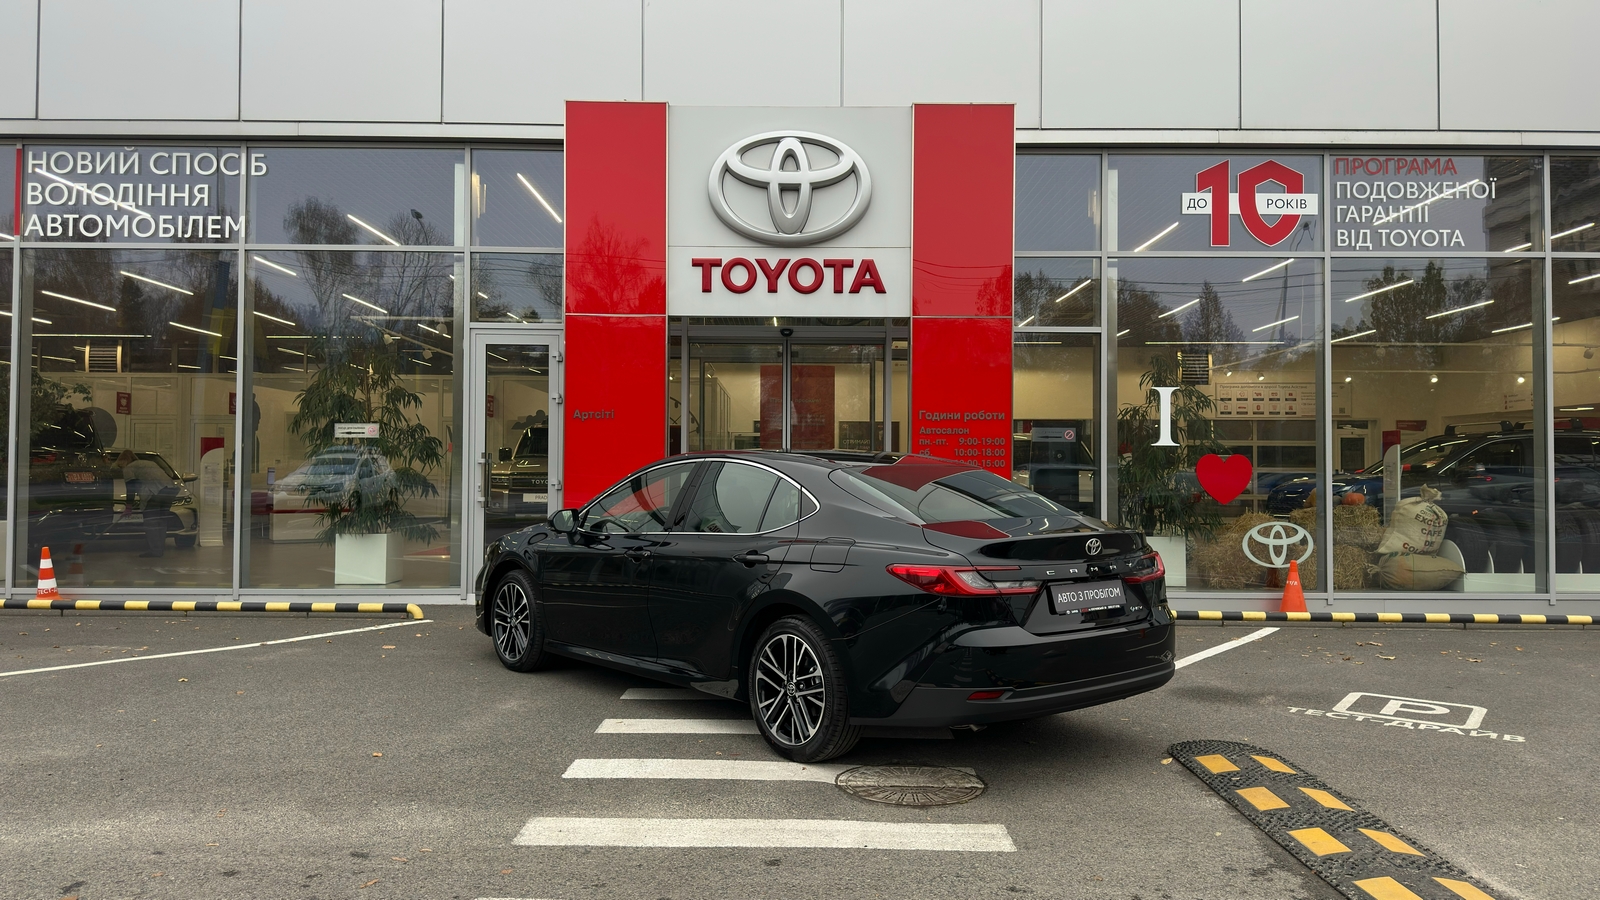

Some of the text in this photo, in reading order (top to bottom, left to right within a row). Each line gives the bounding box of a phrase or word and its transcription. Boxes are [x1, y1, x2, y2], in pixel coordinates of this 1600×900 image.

[28, 147, 268, 177] НОВИЙ СПОСІБ
[1335, 157, 1458, 176] ПРОГРАМА
[26, 182, 210, 211] ВОЛОДІННЯ
[1336, 177, 1498, 202] ПОДОВЖЕНОЇ
[1186, 198, 1208, 211] ДО
[1265, 198, 1308, 210] РОКІВ
[1336, 202, 1429, 223] ГАРАНТІЇ
[24, 213, 246, 239] АВТОМОБІЛЕМ
[1336, 229, 1466, 250] ВІД TOYOTA
[691, 256, 888, 295] TOYOTA
[572, 409, 615, 421] Артсіті
[919, 410, 1005, 422] Години роботи
[1150, 386, 1181, 447] I
[919, 426, 970, 435] Автосалон
[919, 437, 1005, 446] пн.-пт. 9:00-19:00
[919, 448, 1006, 457] сб. 10:00-18:00
[1424, 540, 1436, 548] DE
[1057, 591, 1078, 603] АВТО
[1084, 587, 1121, 600] ПРОБІГОМ
[1286, 706, 1527, 743] ТЕСТ-ДРАЙВ
